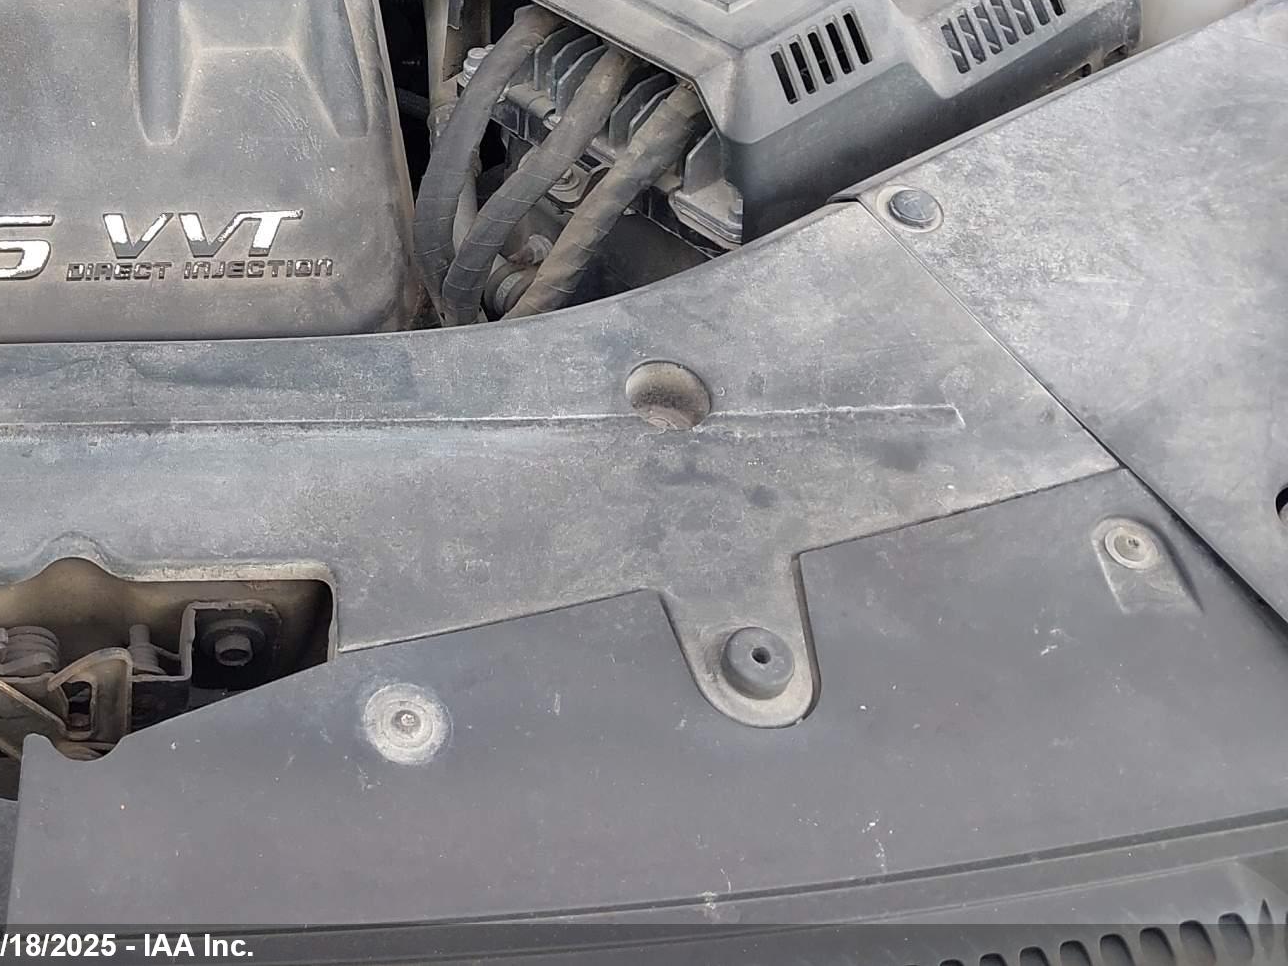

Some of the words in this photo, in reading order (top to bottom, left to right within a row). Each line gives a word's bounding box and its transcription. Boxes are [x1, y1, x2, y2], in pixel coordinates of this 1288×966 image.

[103, 209, 304, 258] VVT
[66, 262, 172, 281] DIRECT
[184, 259, 333, 280] INJECTION
